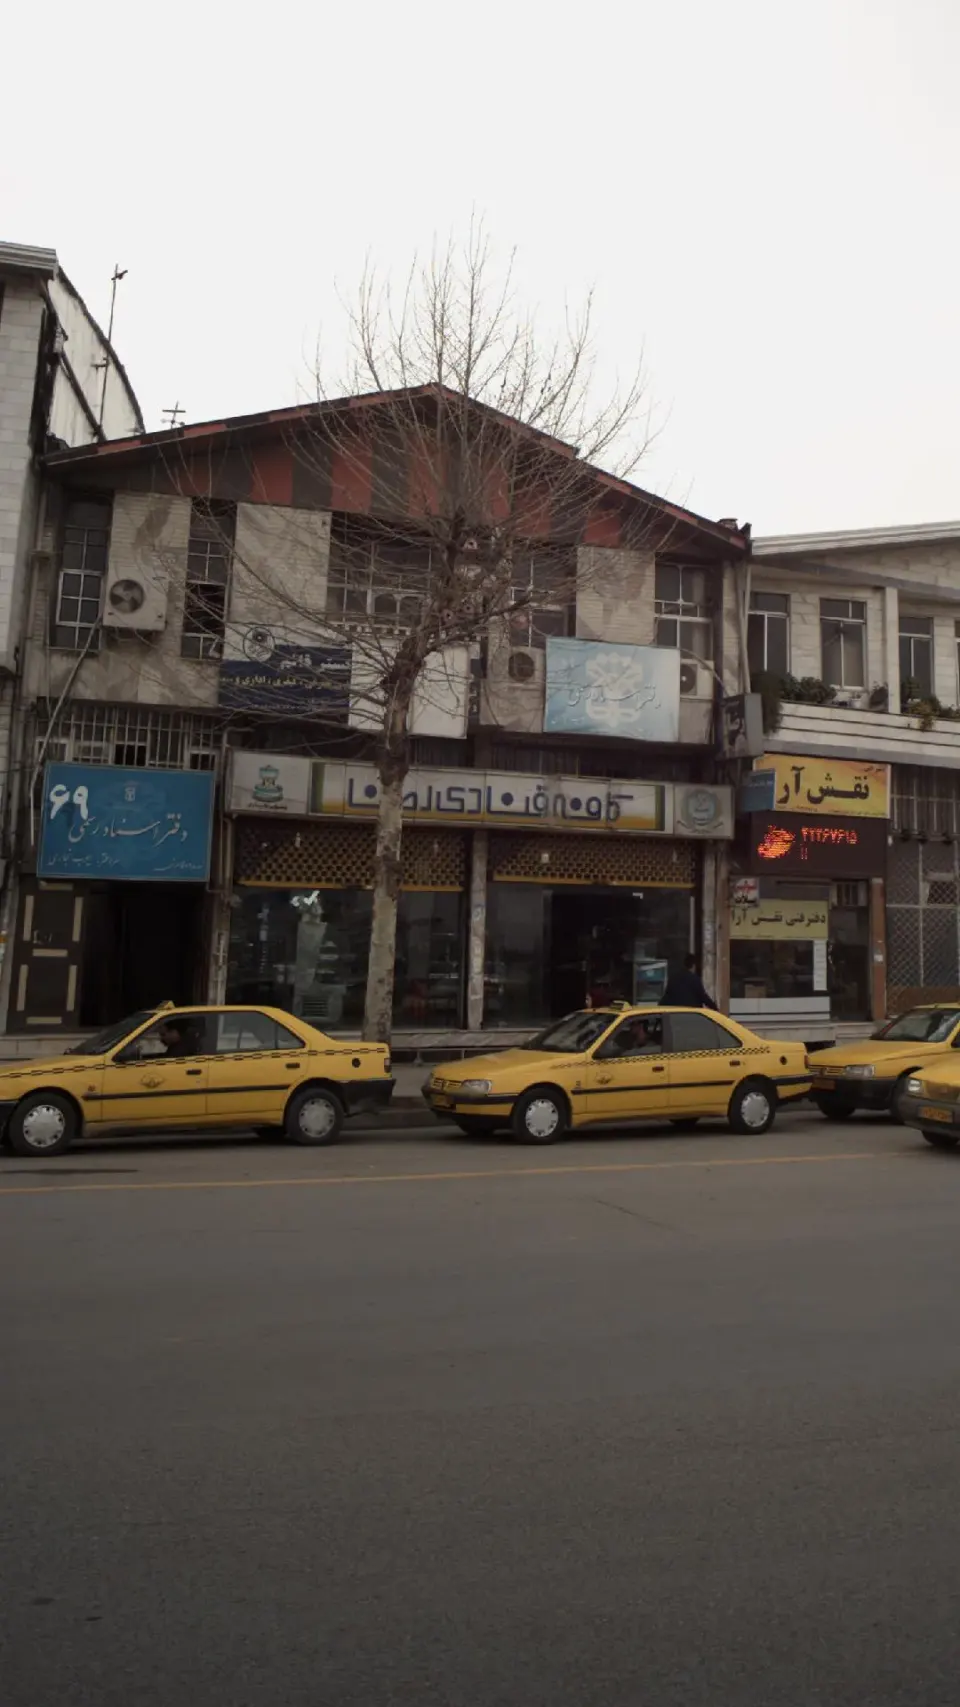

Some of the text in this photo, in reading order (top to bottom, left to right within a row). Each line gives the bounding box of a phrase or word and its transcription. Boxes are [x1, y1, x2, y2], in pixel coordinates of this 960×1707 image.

[49, 784, 88, 820] ۶۹
[436, 785, 549, 817] قنادی
[776, 766, 869, 804] نقش آر
[68, 813, 188, 848] دفتر اسناد رسمی
[731, 906, 826, 927] دفتر فنی نقش آرا
